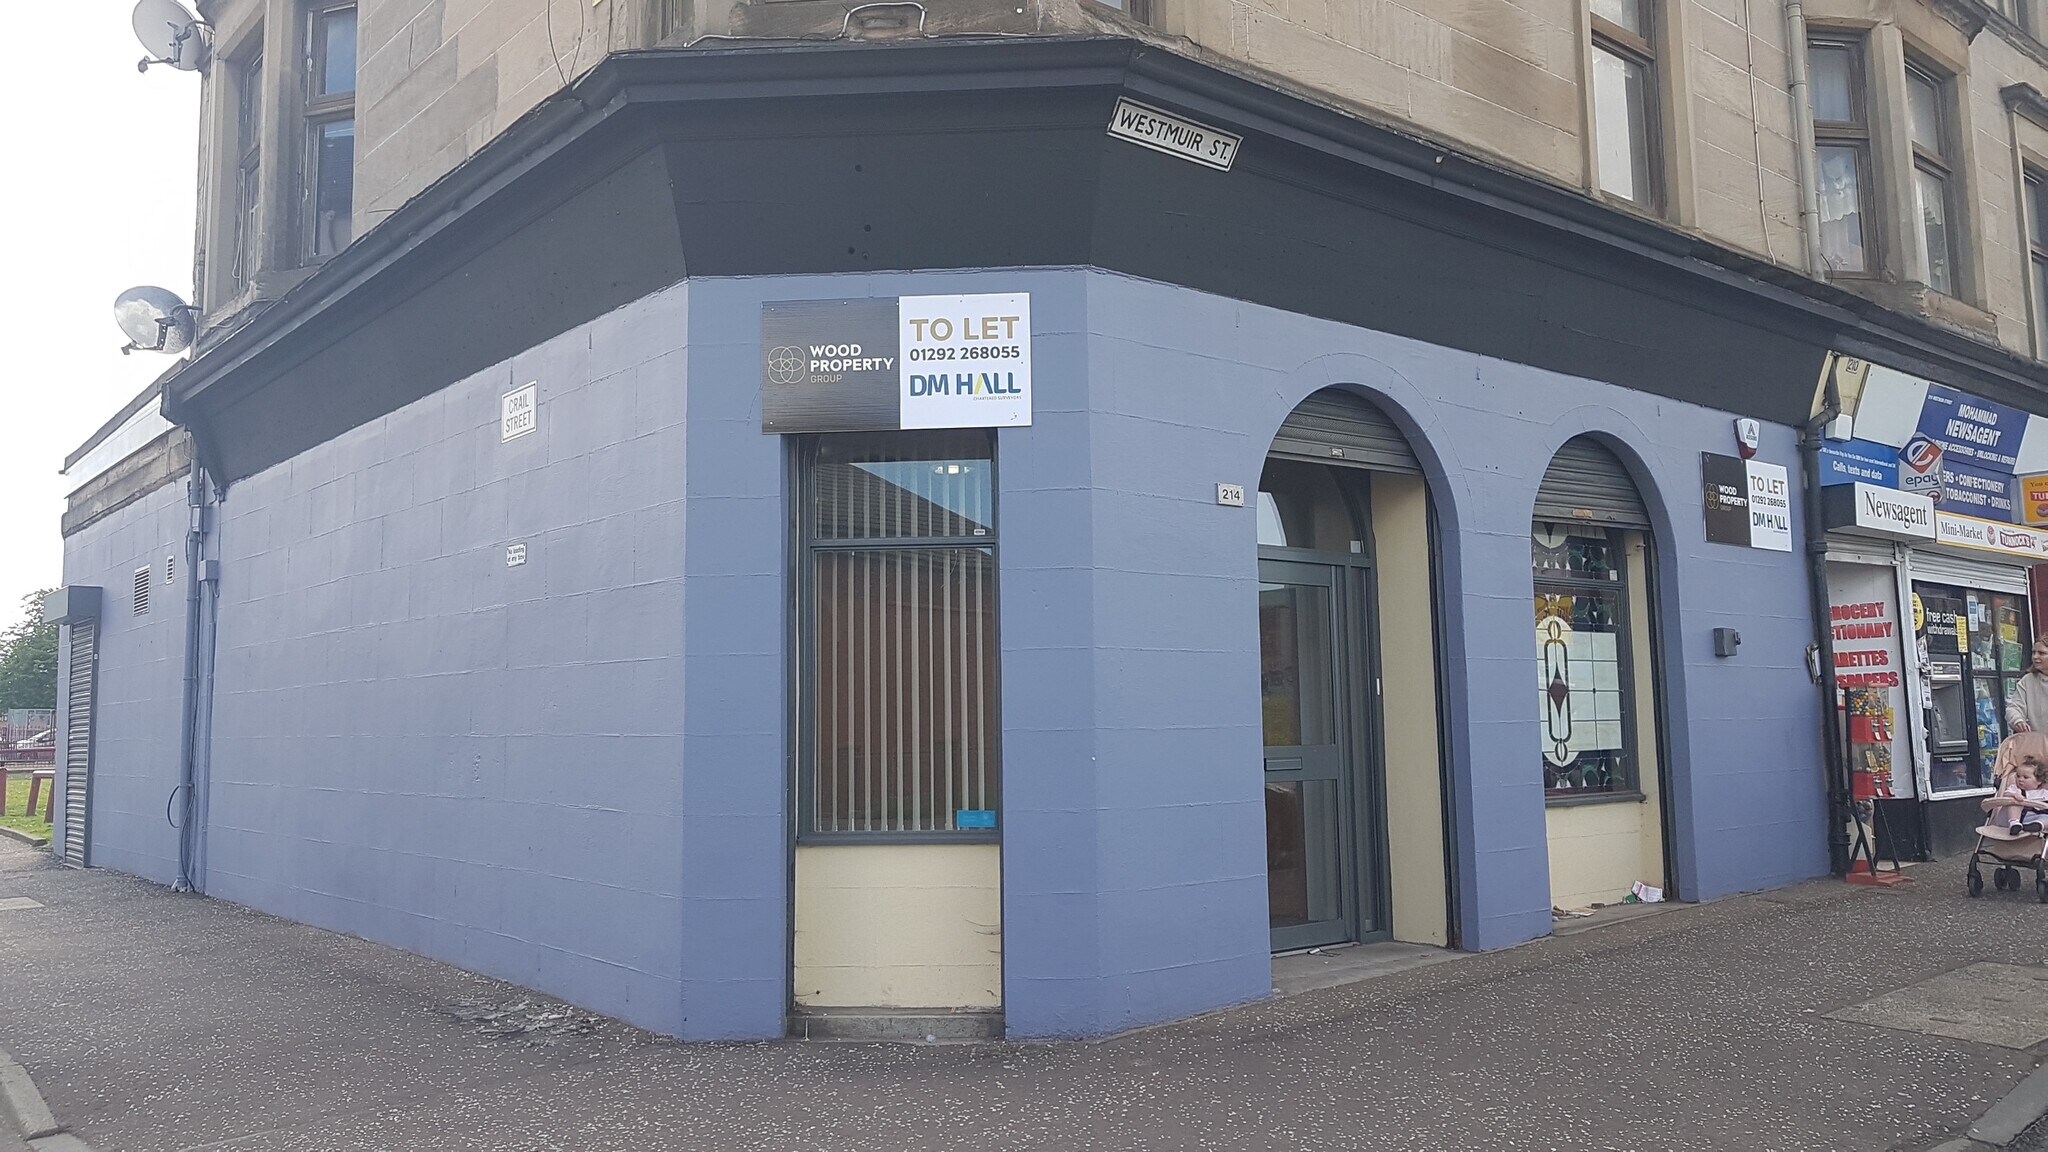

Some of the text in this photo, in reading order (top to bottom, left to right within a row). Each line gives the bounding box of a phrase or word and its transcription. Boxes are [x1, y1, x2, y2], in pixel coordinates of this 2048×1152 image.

[1120, 109, 1231, 160] WESTMUIR ST.
[909, 316, 1020, 341] TO LET
[809, 344, 862, 358] WOOD
[909, 345, 1020, 361] 01292 268055
[810, 357, 894, 372] PROPERTY
[810, 374, 842, 383] GROUP
[910, 372, 1021, 396] DM HALL
[509, 393, 529, 414] CRAIL
[506, 410, 532, 433] STREET
[1958, 404, 1997, 426] MOHAMMAD
[1945, 419, 2001, 447] NEWSAGENT
[1948, 443, 1975, 456] ACCESSORIES
[1848, 464, 1860, 476] texts
[1861, 468, 1870, 478] and
[1871, 470, 1882, 480] data
[1905, 475, 1939, 487] epay
[1718, 485, 1737, 495] WOOD
[1750, 476, 1784, 495] TO LET
[1959, 474, 2005, 494] CONFECTIONERY
[1222, 489, 1240, 501] 214
[1720, 494, 1748, 507] PROPERTY
[1752, 495, 1786, 508] 01292 268055
[1946, 487, 2011, 510] TOBACCONIST DRINKS
[1864, 491, 1927, 529] Newsagent
[1753, 512, 1788, 530] DM HALL
[1940, 521, 1983, 540] Mini-Market
[1830, 602, 1884, 621] ROCERY
[1926, 608, 1940, 622] free
[1942, 610, 1957, 623] cash
